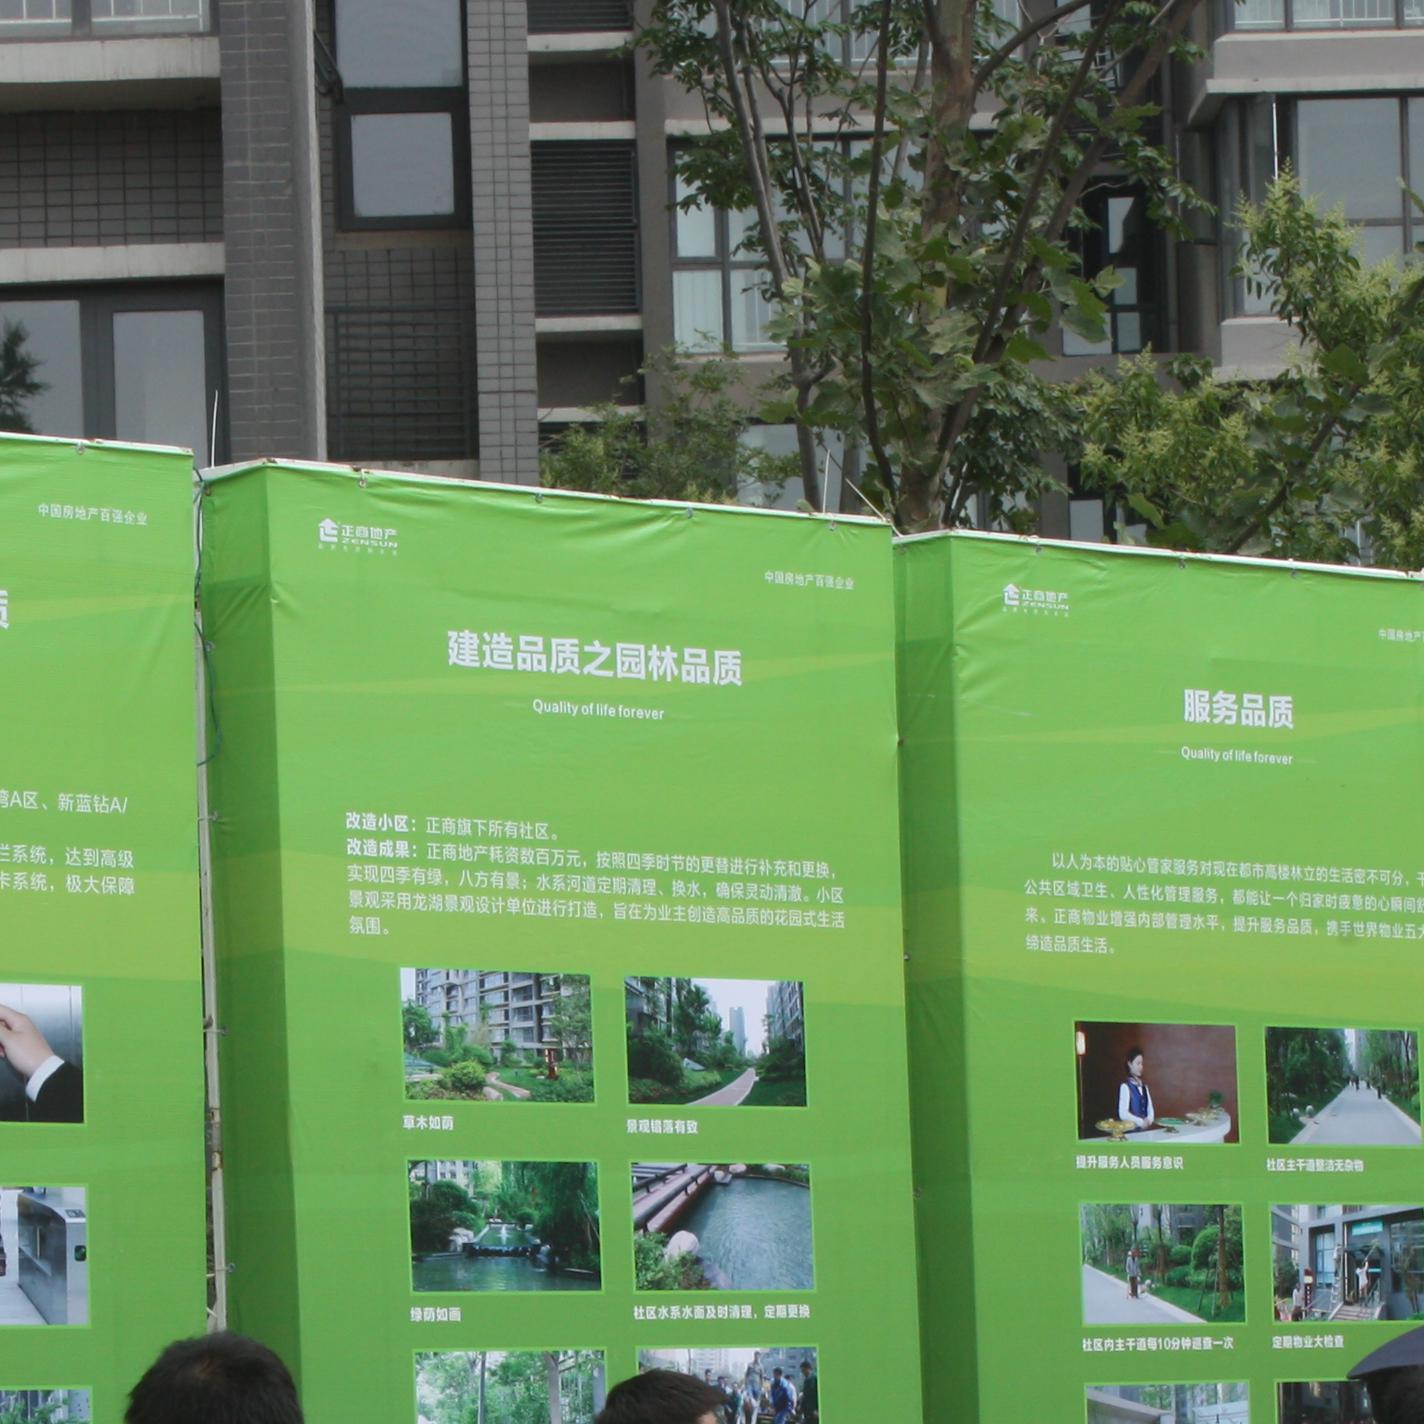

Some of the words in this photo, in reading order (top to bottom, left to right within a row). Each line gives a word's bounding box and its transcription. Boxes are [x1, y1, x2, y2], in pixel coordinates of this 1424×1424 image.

[38, 503, 148, 526] 中国房地产百强企业
[764, 570, 854, 590] 中国房地产百强企业
[446, 629, 743, 686] 建造品质之园林品质
[532, 697, 578, 717] Quality
[580, 700, 594, 716] of
[596, 702, 616, 718] life
[618, 704, 665, 721] forever
[1184, 689, 1294, 729] 服务品质
[1181, 745, 1221, 763] Quality
[1222, 749, 1234, 762] of
[1236, 750, 1252, 764] life
[1253, 751, 1294, 766] forever
[349, 916, 390, 936] 氛围。
[626, 1118, 699, 1135] 景观错落有致
